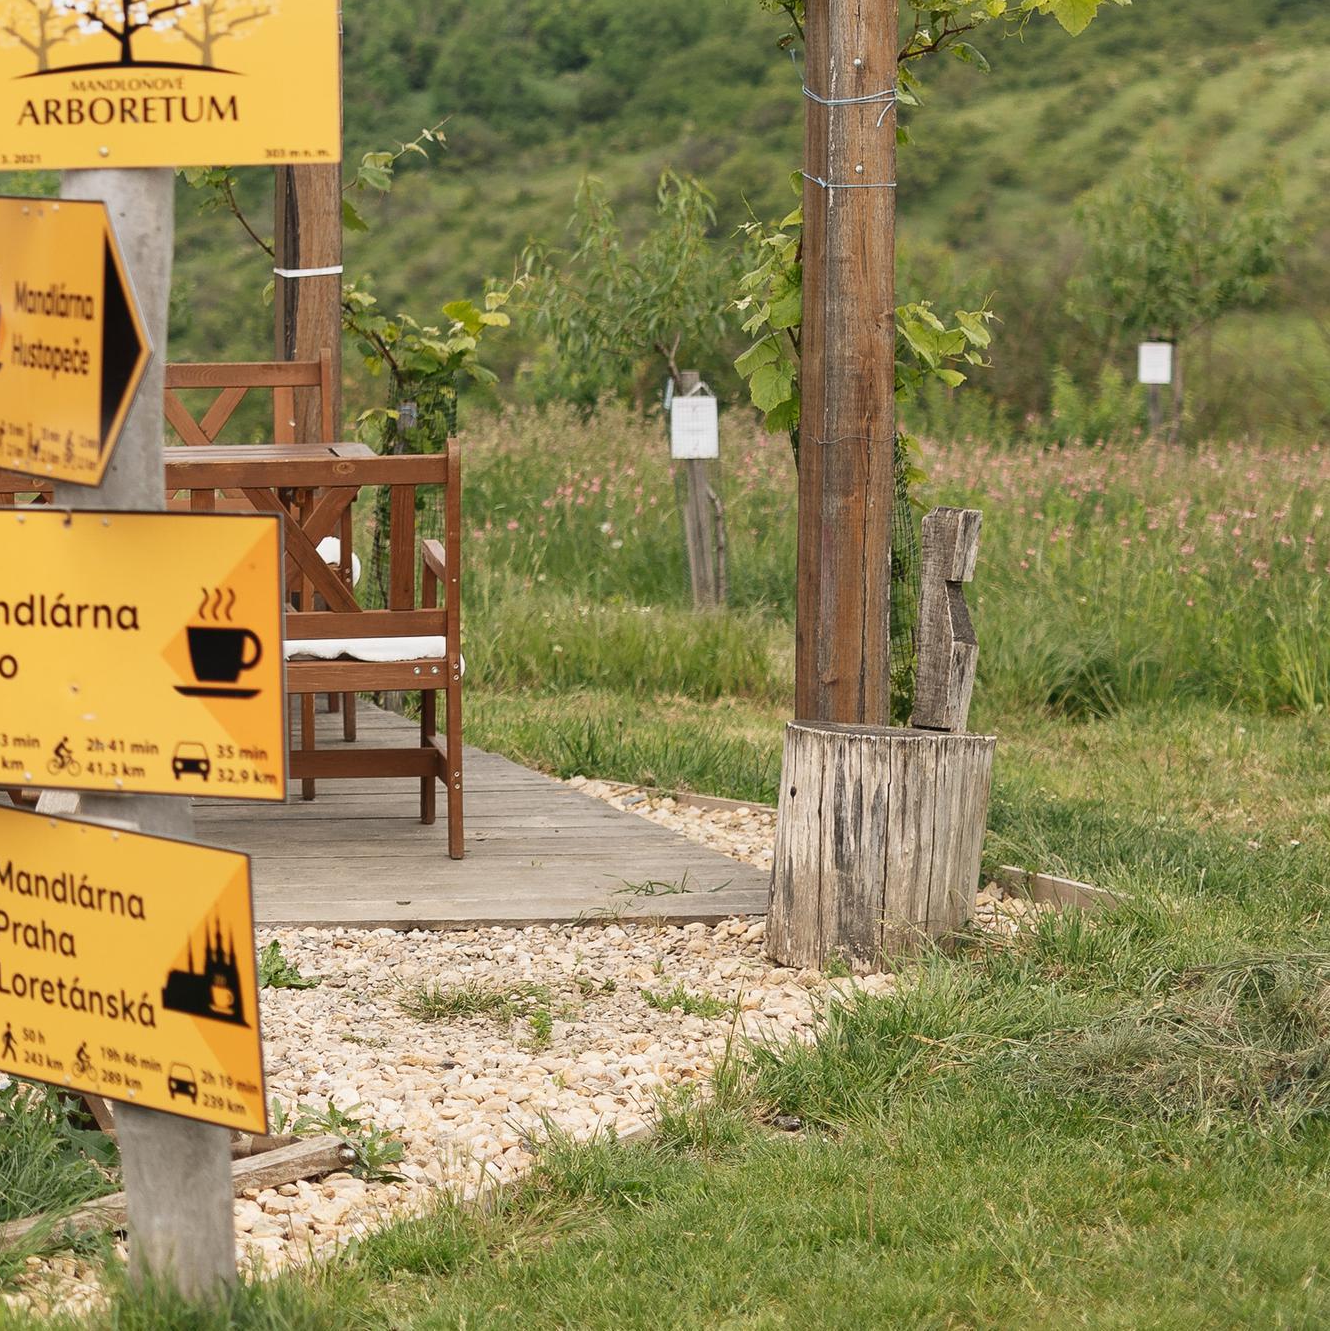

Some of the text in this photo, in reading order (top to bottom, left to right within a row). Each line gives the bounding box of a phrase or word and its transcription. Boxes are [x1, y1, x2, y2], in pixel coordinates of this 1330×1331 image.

[17, 94, 240, 126] ARBORETUM
[14, 281, 94, 321] Mandlárna
[11, 333, 90, 380] Hustopeče
[12, 733, 41, 749] min
[130, 741, 160, 756] min
[216, 744, 268, 762] 35 min
[1, 756, 25, 771] km
[121, 763, 146, 778] km
[253, 770, 278, 786] km
[46, 1054, 64, 1071] km
[140, 1054, 163, 1072] min
[124, 1073, 143, 1090] km
[235, 1077, 259, 1094] min
[226, 1096, 247, 1115] km
